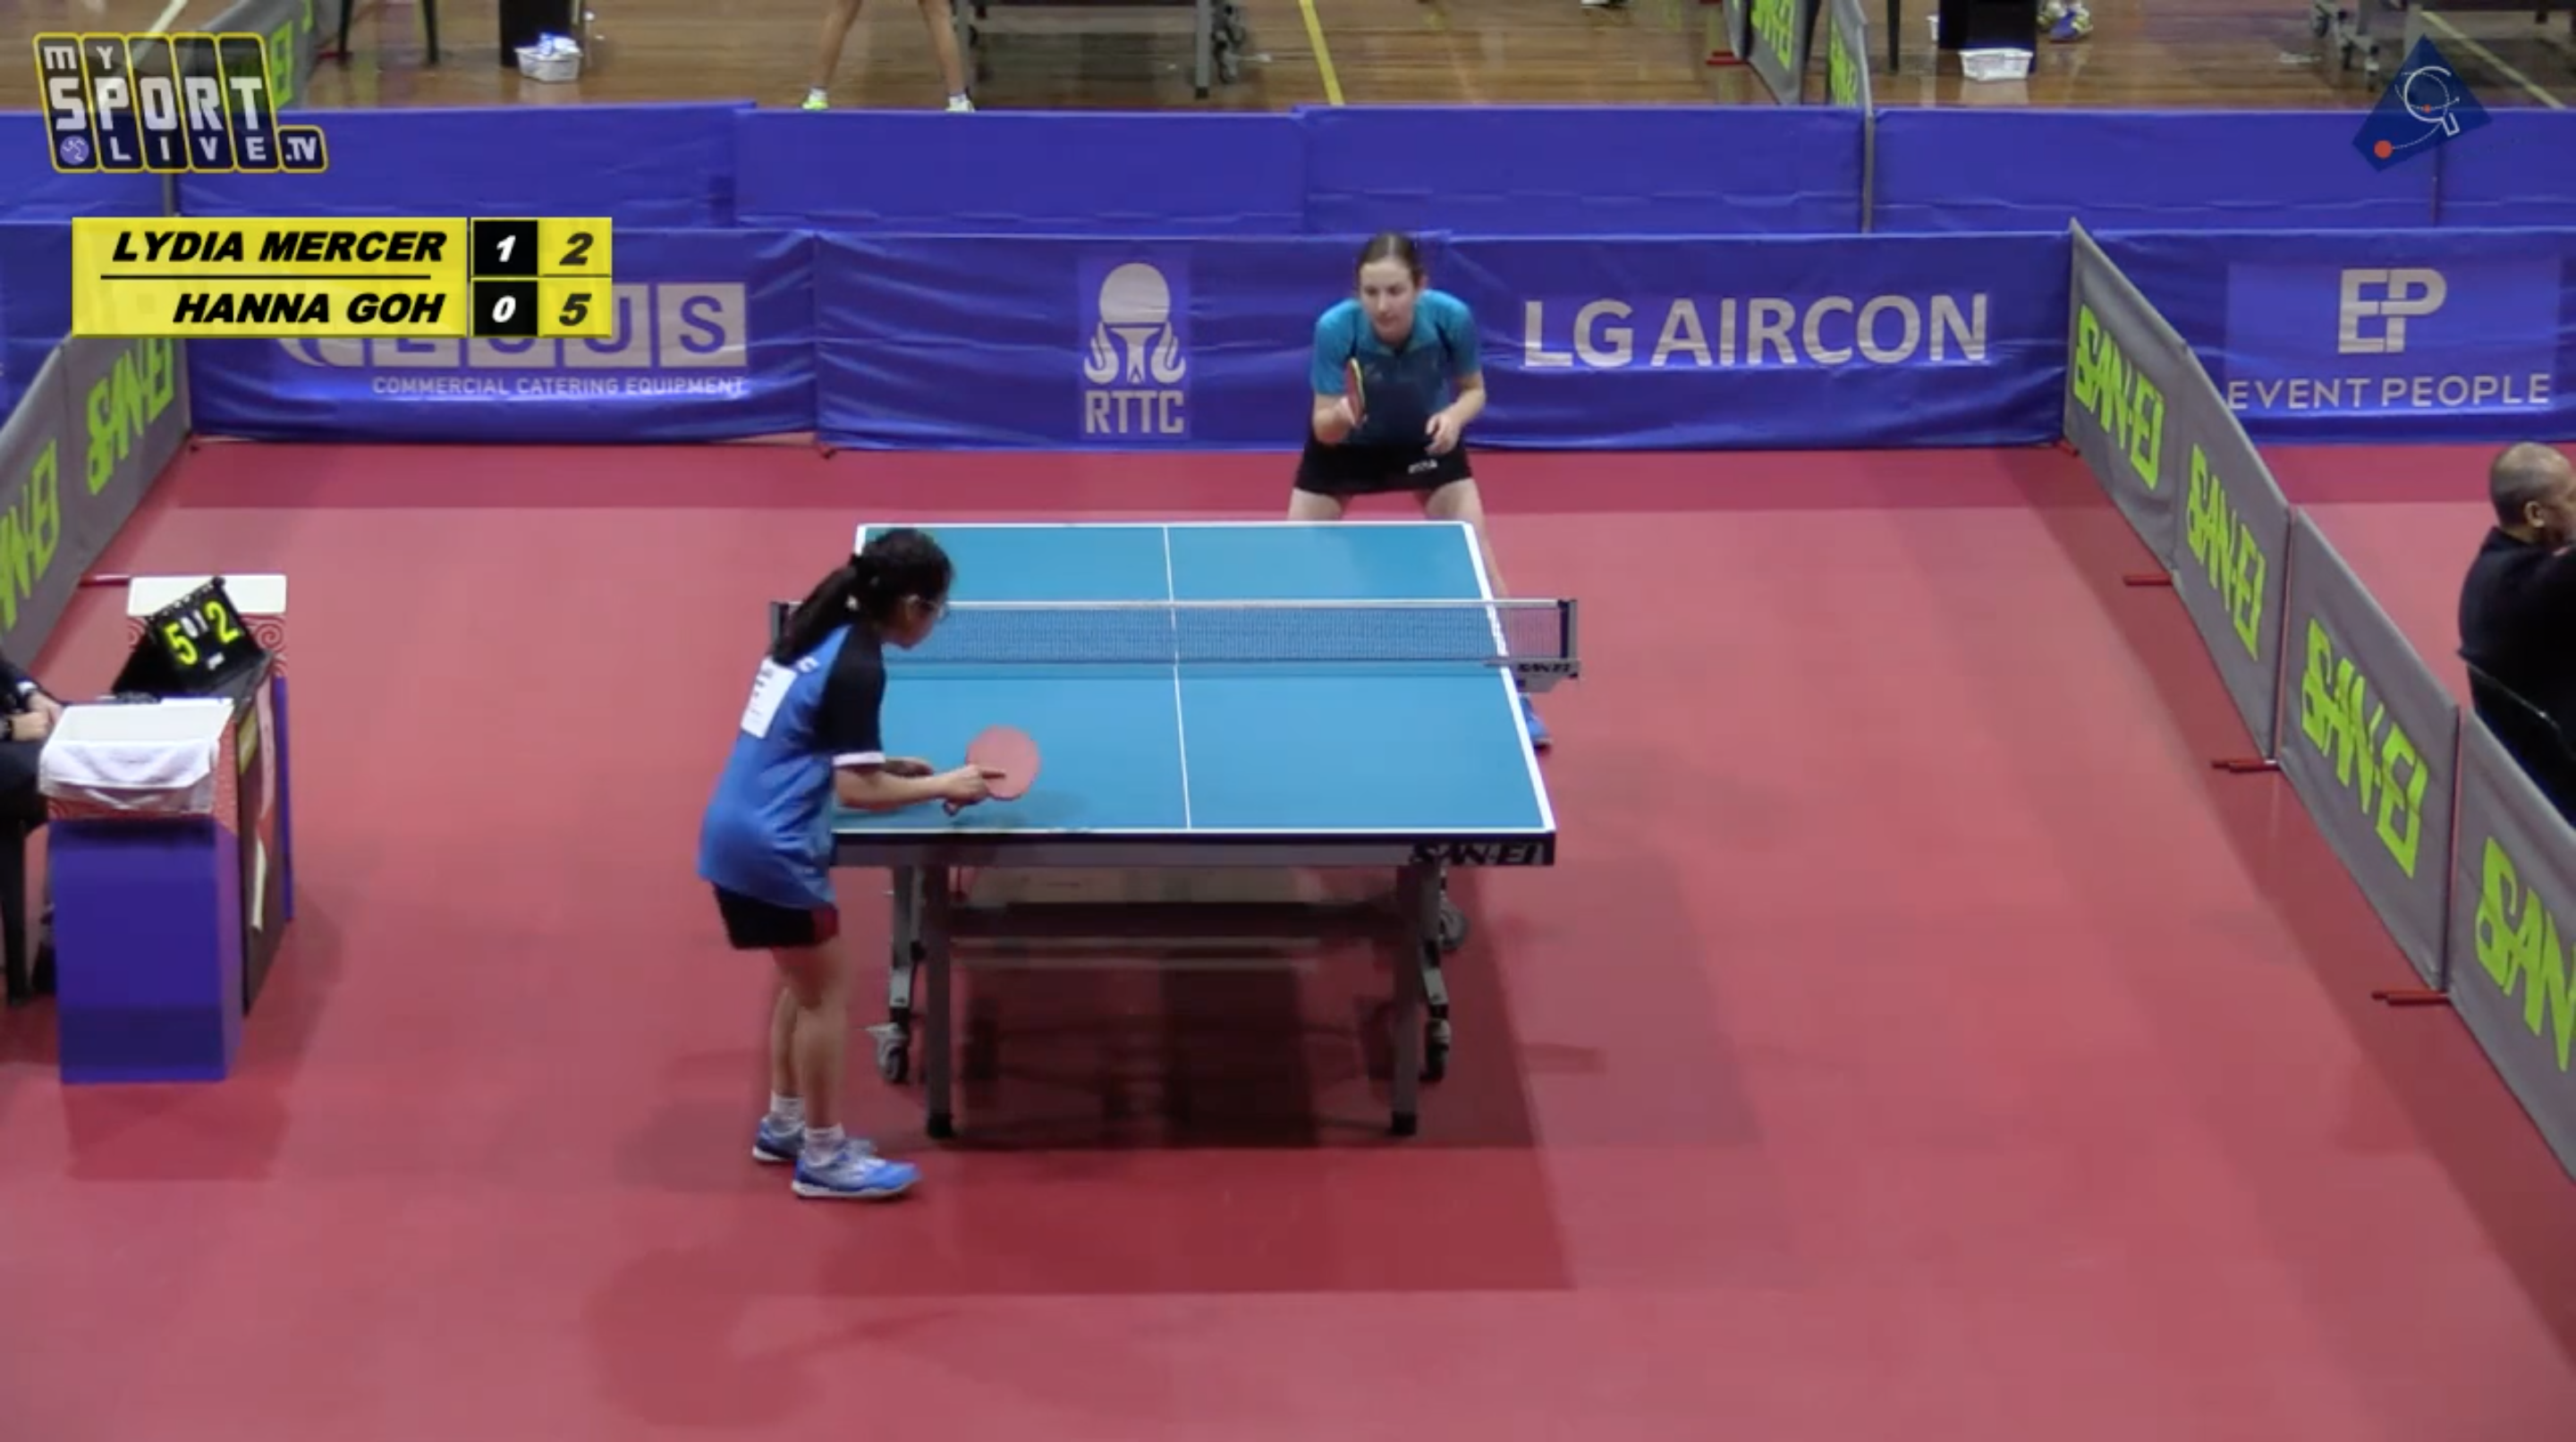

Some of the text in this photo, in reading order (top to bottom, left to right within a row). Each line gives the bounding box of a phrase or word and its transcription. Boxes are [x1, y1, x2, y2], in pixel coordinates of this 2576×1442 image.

[1523, 293, 1988, 368] LG AIRCON
[2338, 268, 2446, 353] EP
[372, 376, 745, 394] COMMERCIAL CATERING EQUIPMENT
[1085, 390, 1184, 434] RTTC
[2226, 374, 2551, 411] EVENT PEOPLE
[165, 623, 198, 665] 5
[204, 600, 239, 643] 2
